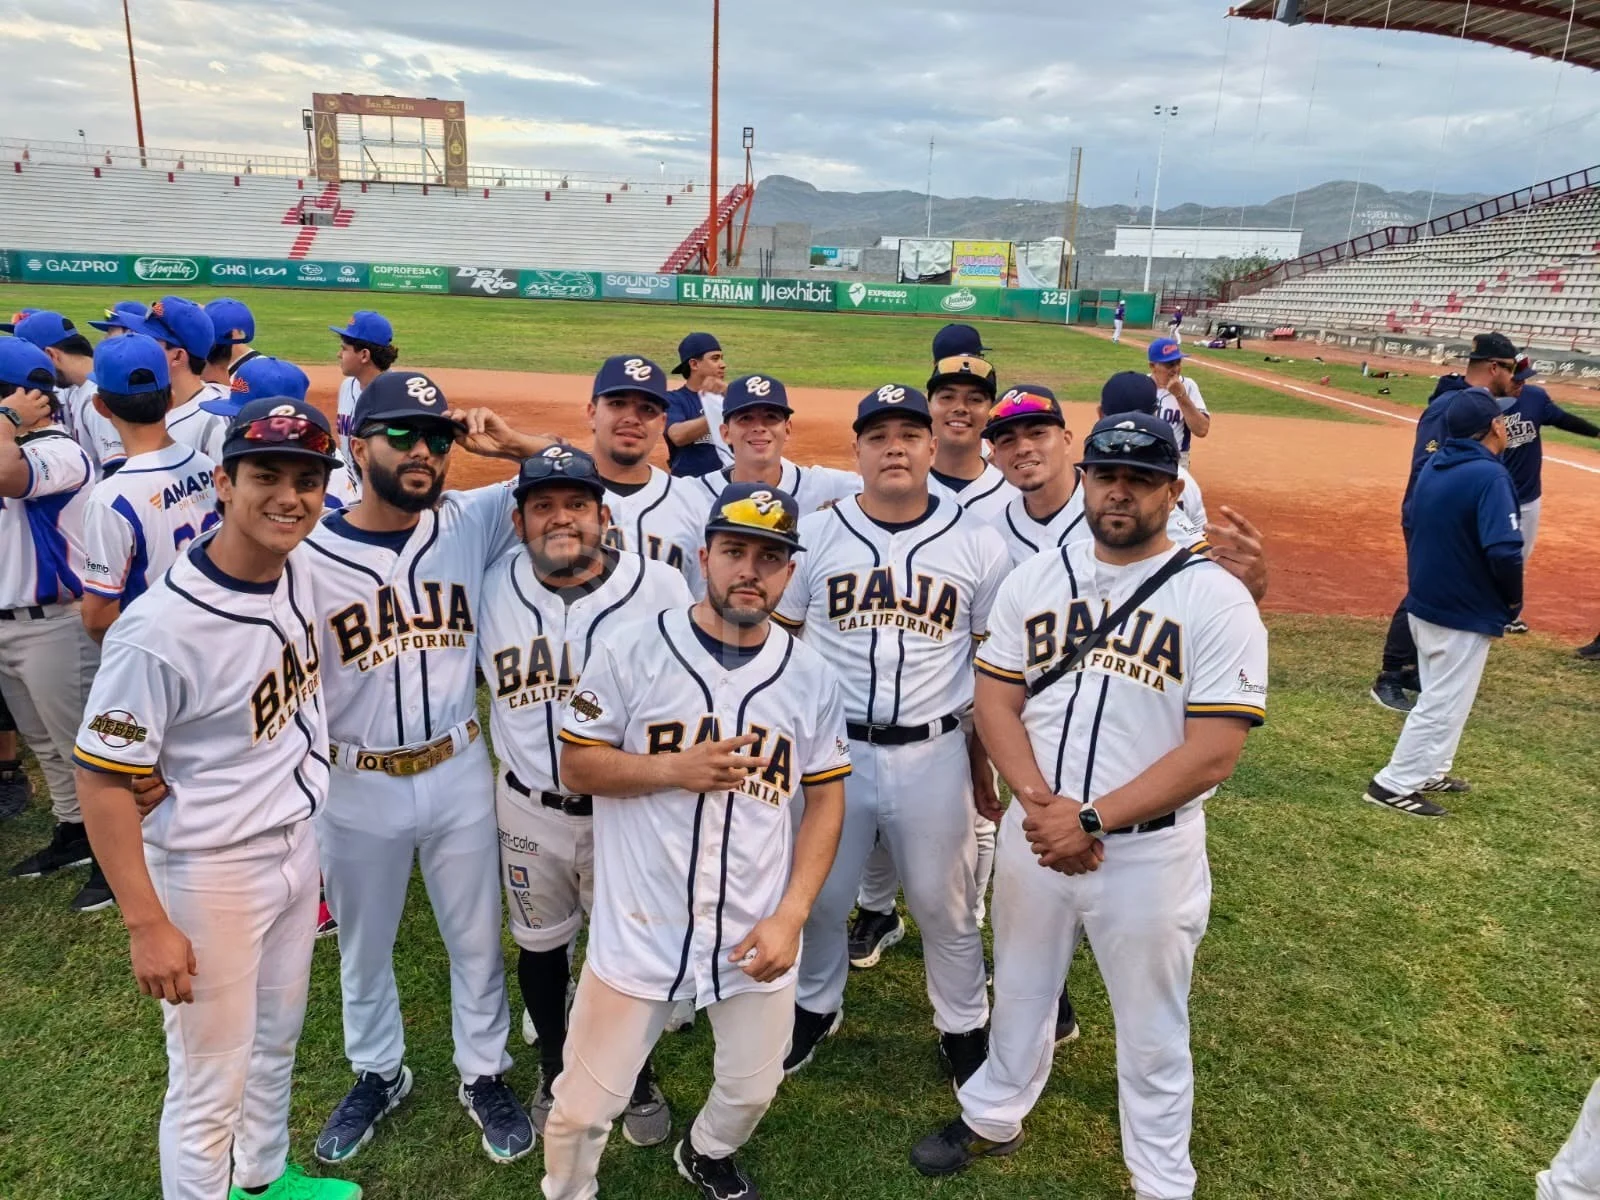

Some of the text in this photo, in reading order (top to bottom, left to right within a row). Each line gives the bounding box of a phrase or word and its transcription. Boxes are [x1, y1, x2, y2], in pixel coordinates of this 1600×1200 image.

[46, 259, 119, 273] GAZPRO
[373, 265, 432, 276] COPROFESA
[456, 266, 503, 278] Del
[606, 274, 670, 288] SOUNDS
[683, 282, 754, 300] EL PARIÁN
[776, 280, 832, 303] exhibit
[867, 289, 907, 298] EXPRESSO
[1040, 291, 1067, 306] 325
[826, 565, 959, 630] BAJA
[327, 580, 476, 667] BAJA
[838, 612, 944, 642] CALIFORNIA
[1024, 598, 1184, 685] BAJA
[357, 634, 467, 673] CALFORNIA
[251, 620, 321, 745] BAJ
